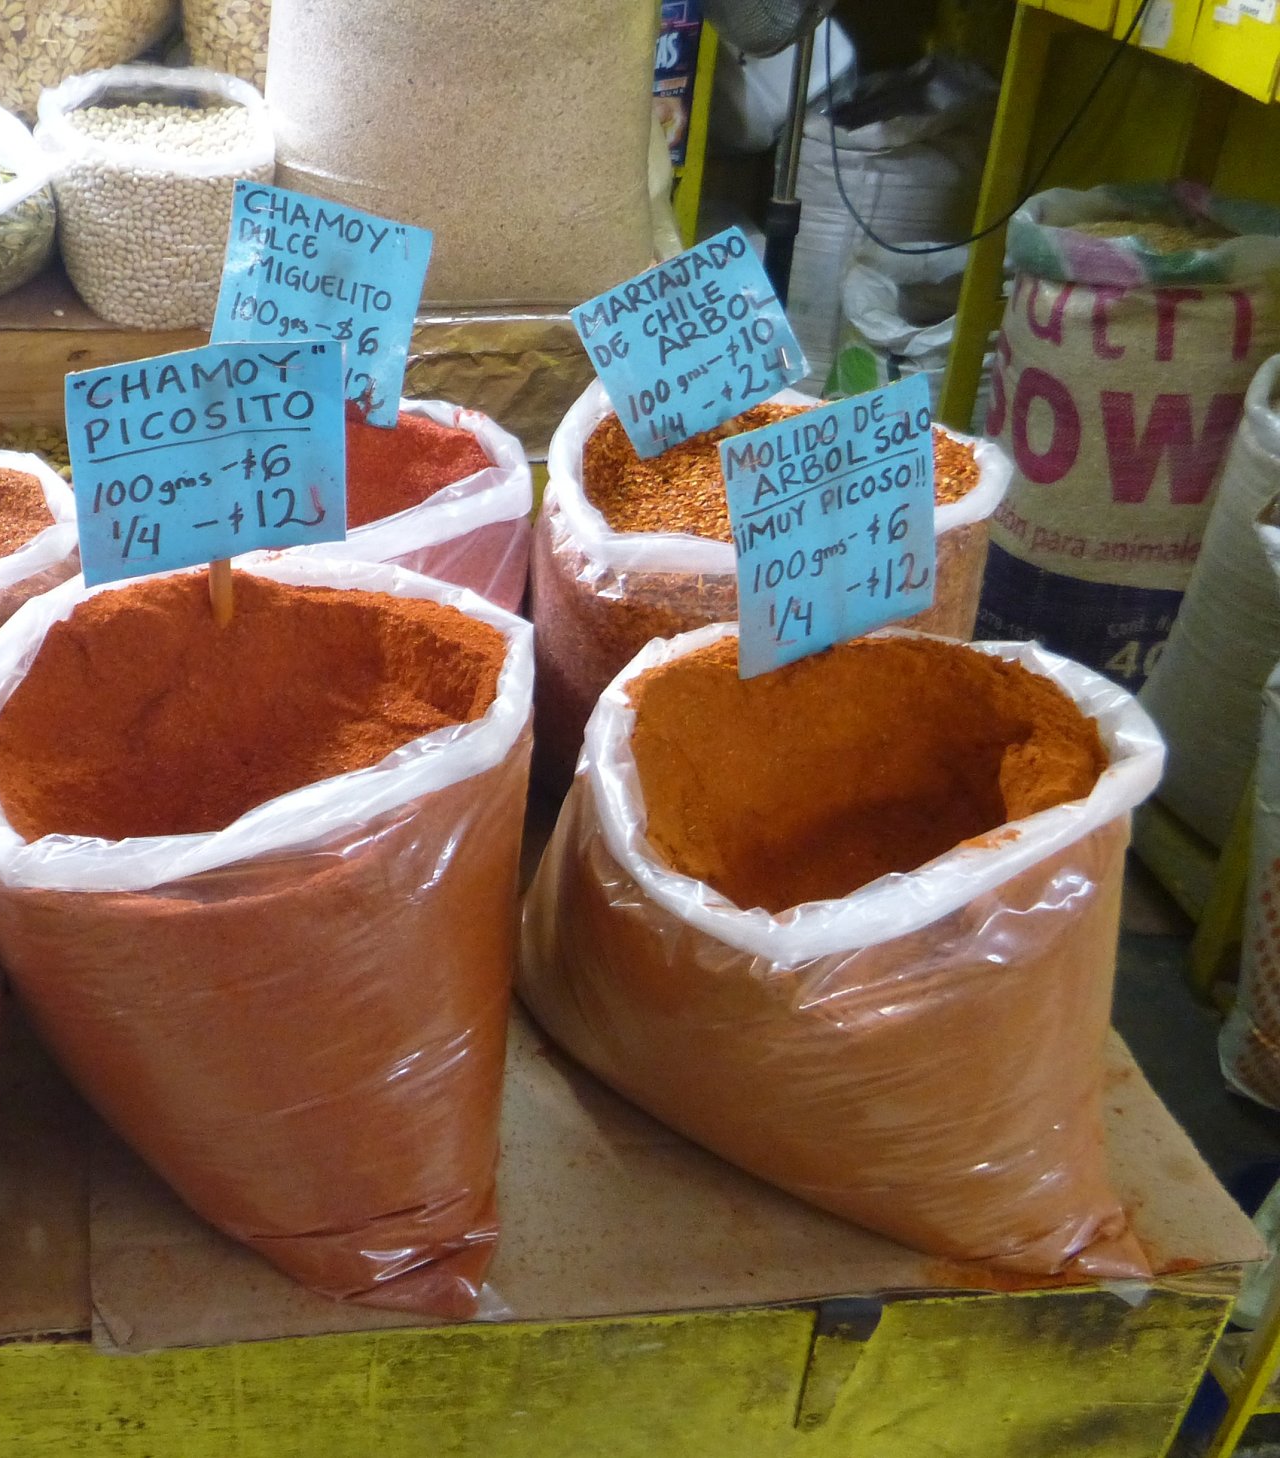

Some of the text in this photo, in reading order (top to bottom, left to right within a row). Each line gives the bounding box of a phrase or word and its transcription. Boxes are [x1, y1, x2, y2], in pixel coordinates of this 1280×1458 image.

[239, 218, 318, 259] DULCE
[248, 252, 392, 314] MIGUELITO
[579, 236, 746, 339] MARTAJADO
[593, 280, 726, 368] DE CHILE
[658, 290, 777, 367] ARBOL
[73, 345, 326, 410] "CHAMOY"
[84, 390, 315, 454] PICOSITO
[727, 394, 885, 481] MOLIDO DE
[753, 407, 931, 505] ARBOL SOLO
[821, 455, 926, 515] PICOSO!!
[112, 516, 160, 558] 1/4
[769, 596, 812, 641] 1/4
